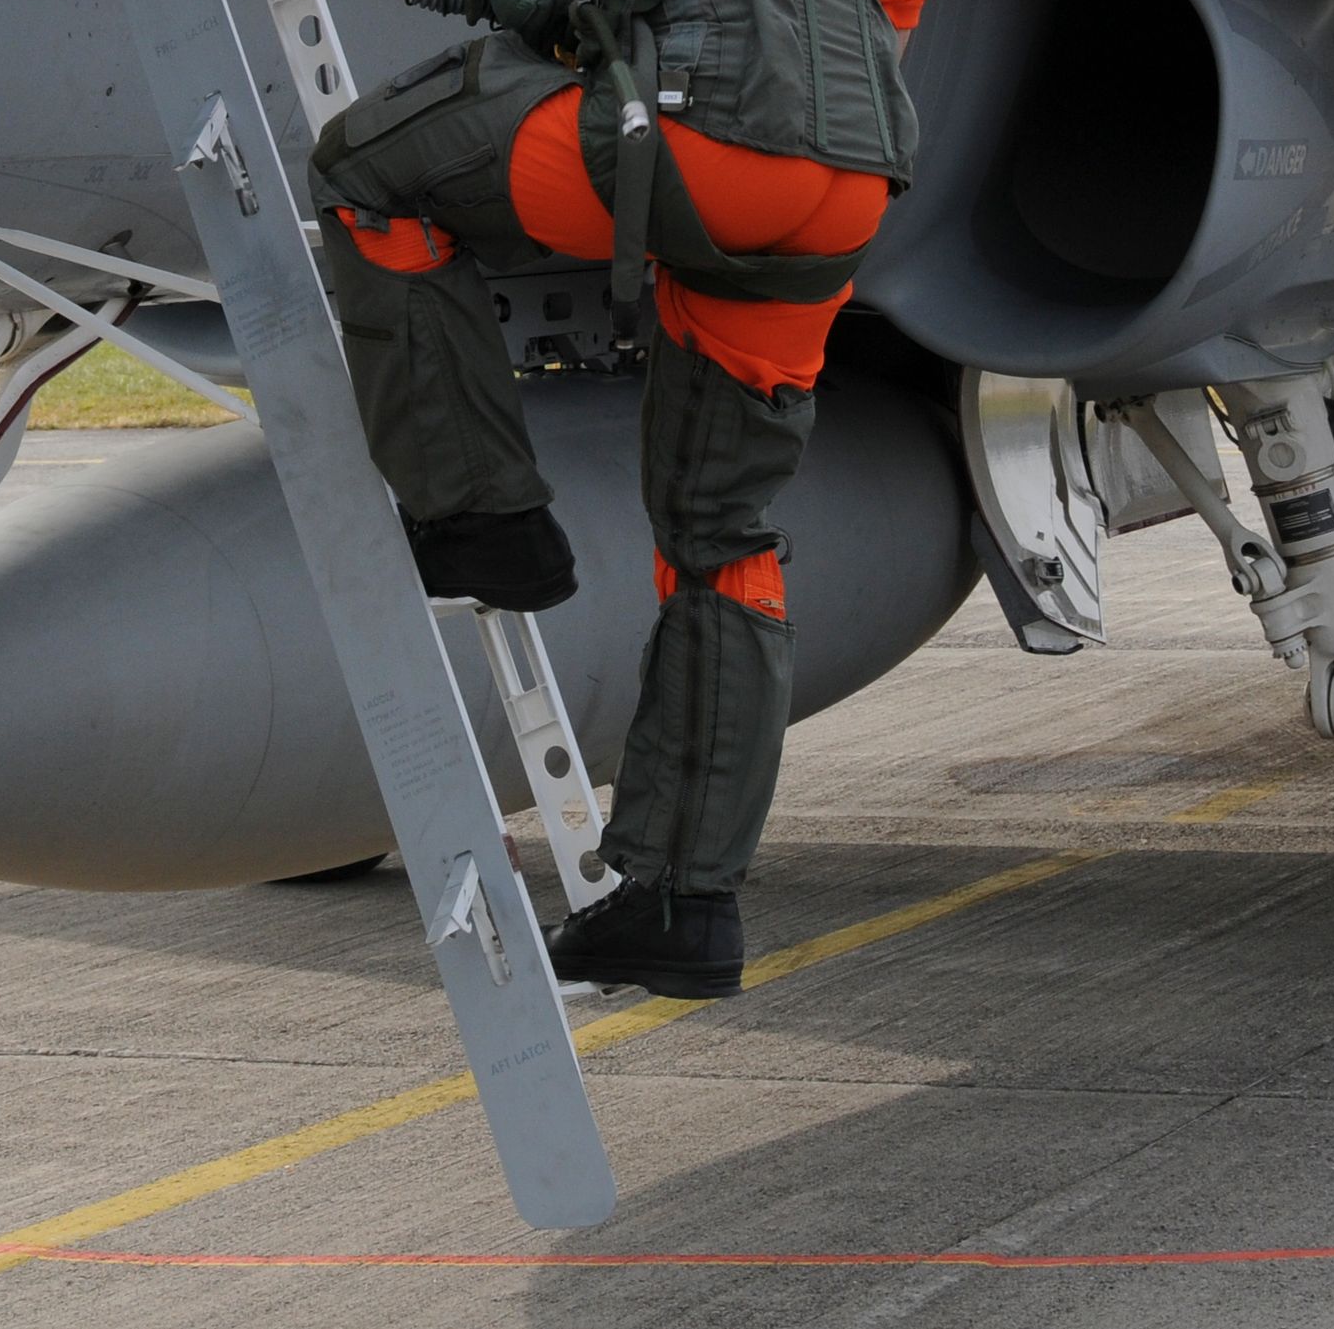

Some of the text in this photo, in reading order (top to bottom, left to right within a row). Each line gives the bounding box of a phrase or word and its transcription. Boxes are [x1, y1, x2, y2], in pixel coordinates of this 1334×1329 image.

[1255, 144, 1308, 177] DANGER
[491, 1040, 552, 1076] AFT LATCH
